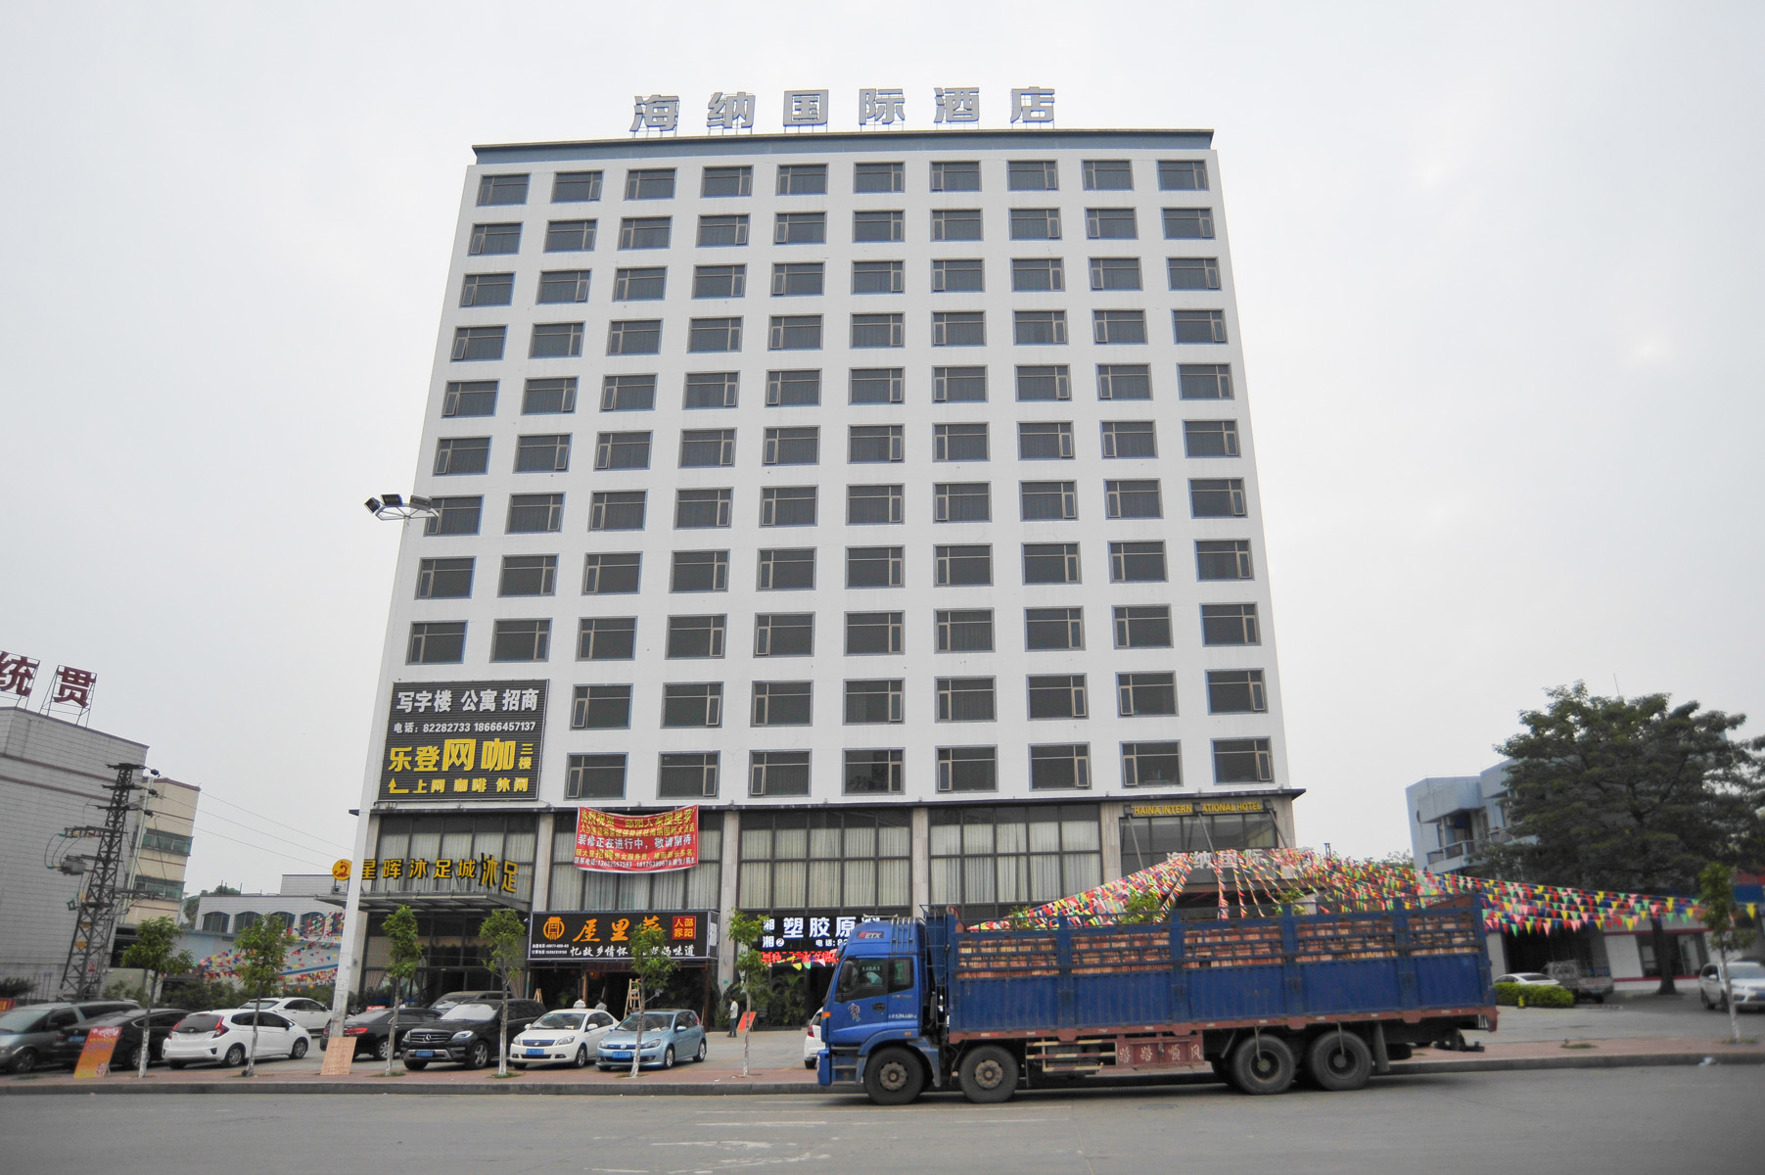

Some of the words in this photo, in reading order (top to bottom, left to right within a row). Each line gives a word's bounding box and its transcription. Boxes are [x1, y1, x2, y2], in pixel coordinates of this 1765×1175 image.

[629, 86, 1056, 133] 海纳国际酒店
[396, 689, 453, 713] 写字楼
[460, 688, 498, 712] 公寓
[502, 688, 540, 711] 招商
[474, 721, 536, 732] 18666457137
[388, 737, 517, 772] 乐登网咖
[518, 743, 534, 770] 三楼
[412, 778, 446, 794] 上网
[453, 778, 488, 793] 咖啡
[1236, 801, 1263, 812] HOTEL
[480, 852, 518, 893] 沐足
[783, 916, 880, 939] 塑胶原
